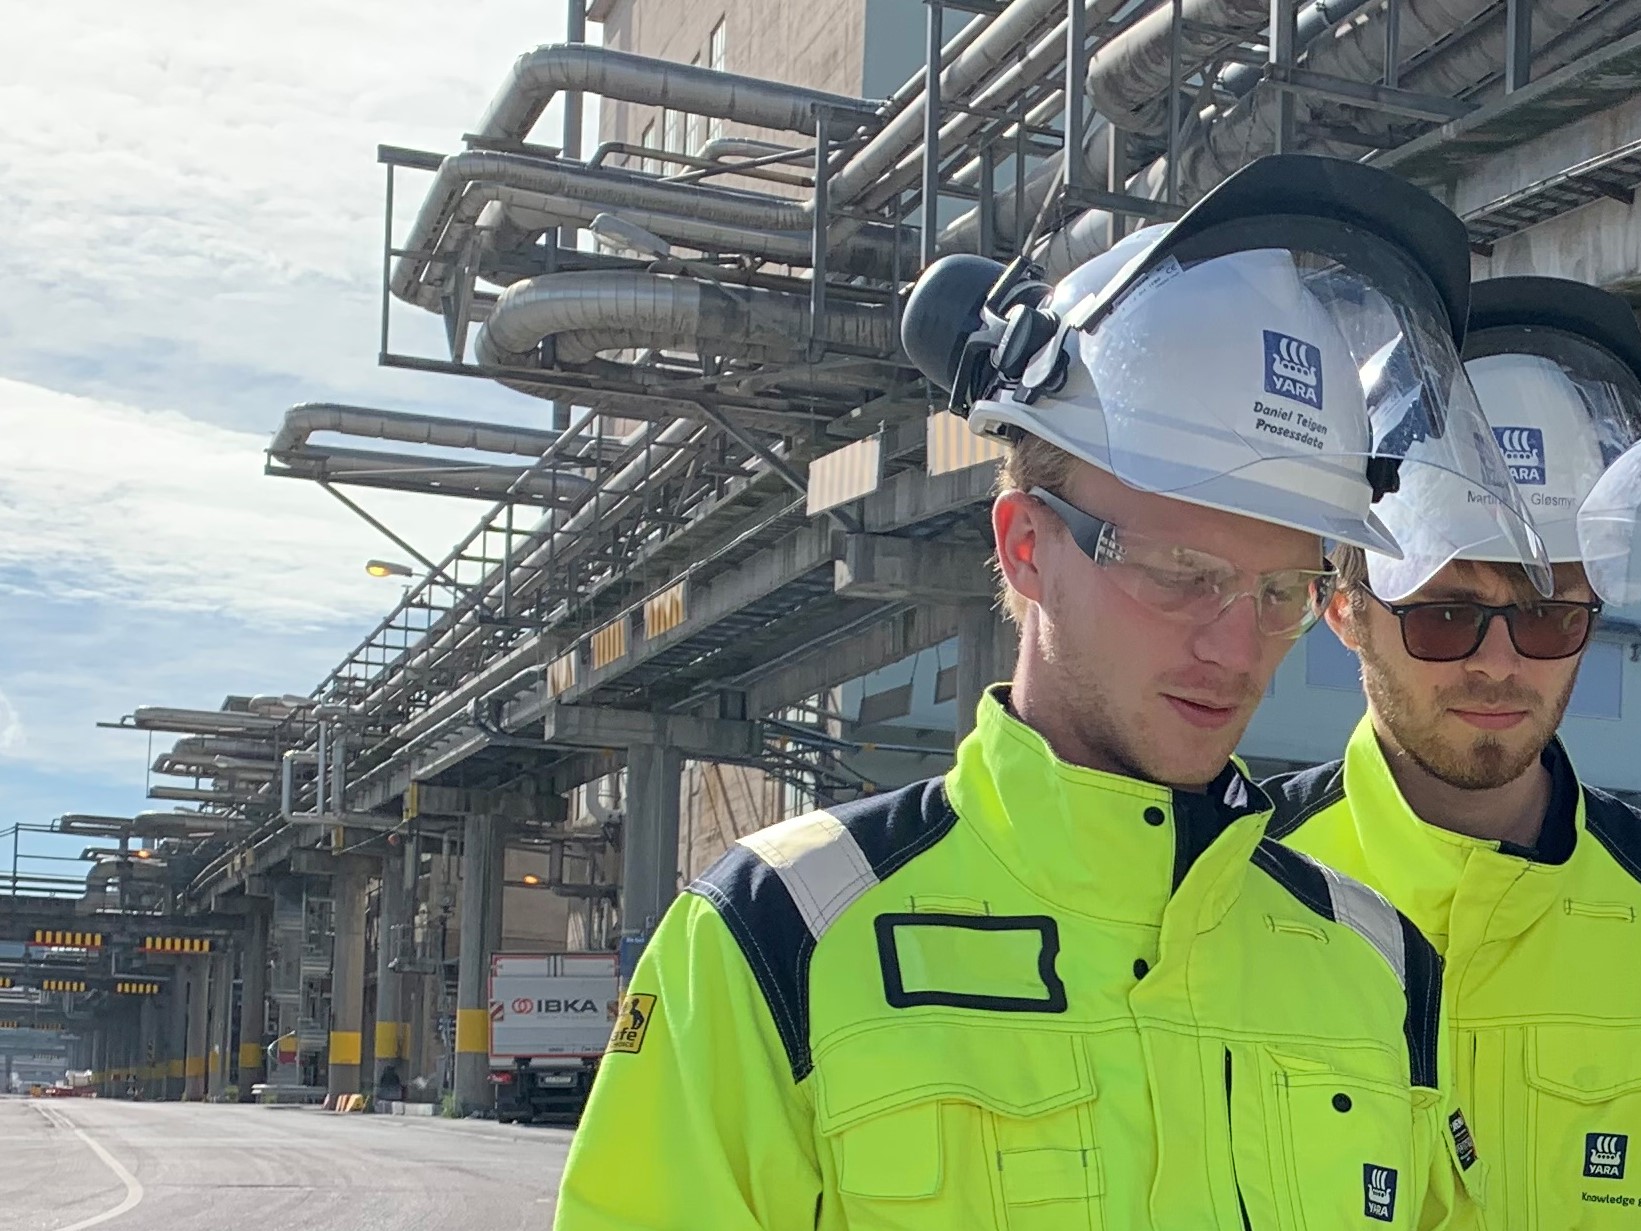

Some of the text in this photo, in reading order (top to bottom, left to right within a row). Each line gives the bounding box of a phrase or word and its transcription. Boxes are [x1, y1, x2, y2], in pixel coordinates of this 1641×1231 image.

[1272, 375, 1318, 403] YARA
[1253, 401, 1328, 435] Daniel Teigen
[1255, 418, 1324, 449] Prosessdata
[1509, 467, 1540, 480] ARA
[537, 999, 598, 1013] IBKA
[611, 1027, 637, 1042] afe
[1588, 1164, 1620, 1176] YARA
[1582, 1192, 1635, 1207] Knowledge
